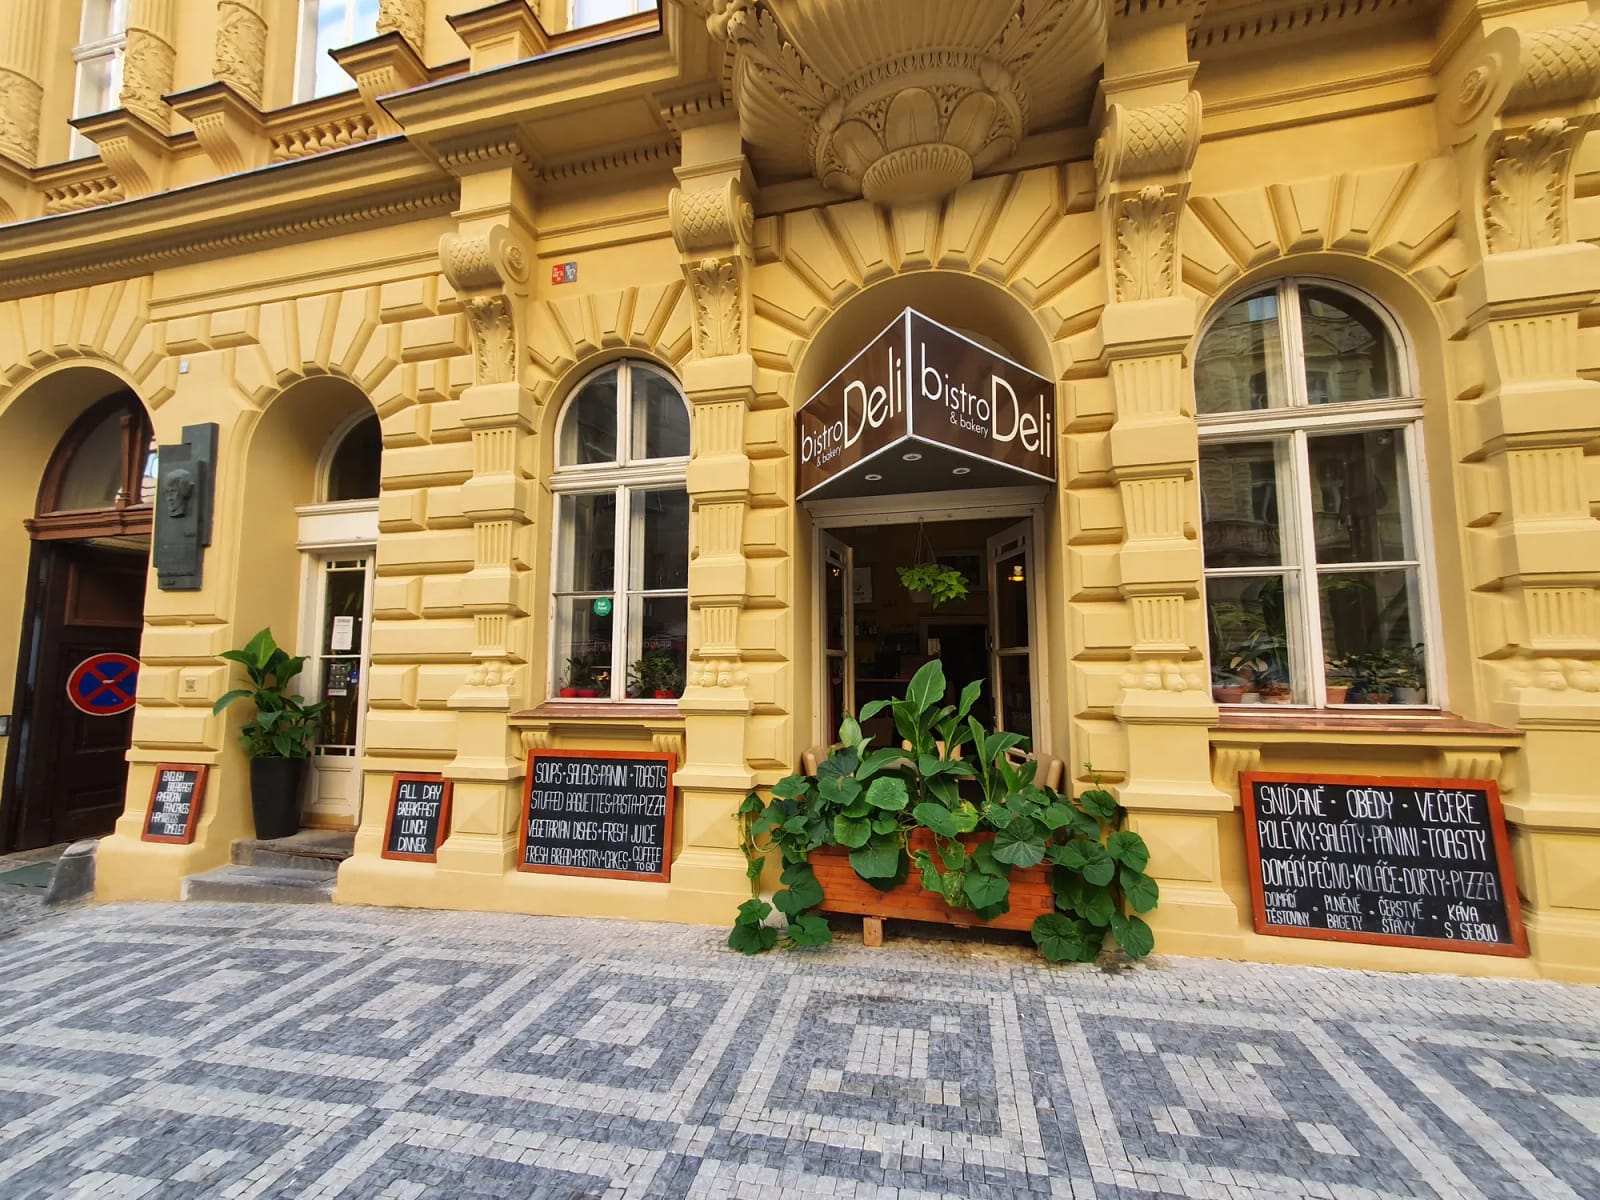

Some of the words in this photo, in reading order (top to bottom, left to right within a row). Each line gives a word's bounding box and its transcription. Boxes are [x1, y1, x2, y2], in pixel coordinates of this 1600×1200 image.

[801, 420, 843, 464] bistro
[843, 346, 902, 449] Deli
[921, 342, 990, 421] bistro
[991, 374, 1051, 458] Deli
[960, 416, 989, 438] bakery
[822, 445, 842, 464] bakery
[535, 762, 562, 784] SOUPS
[566, 763, 599, 785] SALADS
[633, 765, 667, 788] TOASTS
[399, 783, 417, 799] ALL
[422, 784, 443, 800] DAY
[397, 801, 440, 818] BREAKFAST
[531, 790, 564, 811] STUFFED
[566, 792, 611, 814] BAGUETTES
[612, 794, 638, 815] PASTA
[638, 794, 667, 816] PIZZA
[1260, 783, 1327, 817] SNÍDANĚ
[1346, 787, 1393, 820] OBĚDY
[1414, 790, 1480, 825] VEČEŘE
[401, 819, 428, 835] LUNCH
[528, 818, 571, 839] VEGETARIAN
[573, 821, 597, 841] DISHES
[602, 822, 628, 842] FRESH
[631, 824, 656, 844] JUICE
[397, 836, 427, 853] DINNER
[1258, 816, 1316, 851] POLÉVKY
[1318, 819, 1366, 854] SALÁTY
[1371, 824, 1420, 857] PANINI
[1422, 827, 1487, 861] TOASTY
[525, 845, 548, 864] FRESH
[551, 847, 572, 866] BREAD
[573, 848, 603, 867] PASTRY
[604, 850, 629, 870] CAKES
[632, 845, 662, 863] COFFEE
[635, 861, 645, 871] TO
[645, 862, 656, 872] GO
[1261, 854, 1308, 888] DOMÁCÍ
[1308, 856, 1351, 889] PEČIVO
[1353, 859, 1400, 893] KOLÁČE
[1402, 867, 1446, 896] DORTY
[1450, 870, 1498, 901] PIZZA
[1264, 888, 1297, 908] DOMÁCÍ
[1323, 892, 1362, 914] PLNĚNÉ
[1378, 896, 1425, 919] ČERSTVÉ
[1265, 907, 1310, 927] TĚSTOVINY
[1326, 913, 1363, 931] BAGETY
[1447, 901, 1480, 922] KÁVA
[1444, 922, 1454, 939] S
[1460, 922, 1499, 942] SEBOU
